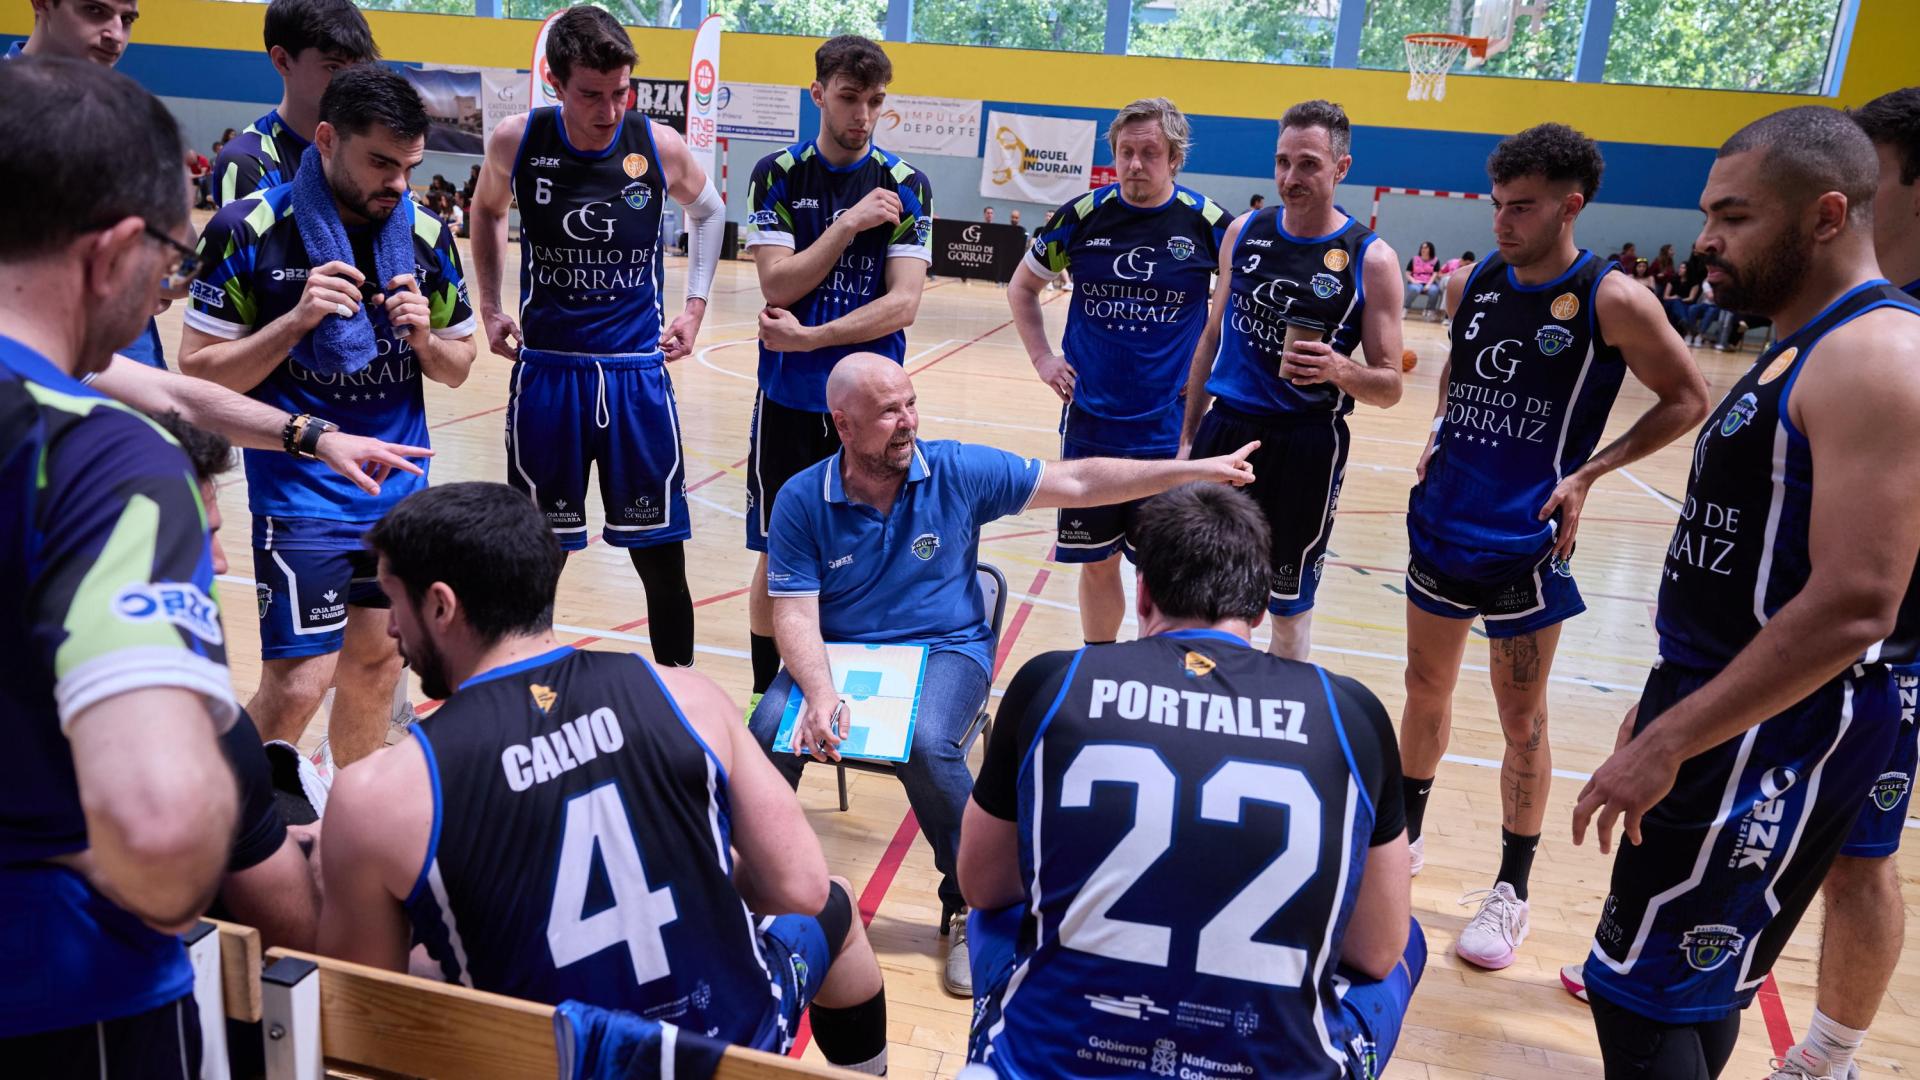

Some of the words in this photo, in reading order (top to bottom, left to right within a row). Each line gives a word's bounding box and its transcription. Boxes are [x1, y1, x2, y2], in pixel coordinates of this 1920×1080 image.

[637, 82, 684, 112] BZK
[691, 117, 713, 133] FNB
[904, 123, 975, 137] DEPORTE
[905, 111, 976, 124] IMPULSA
[690, 133, 713, 148] NSF
[1024, 161, 1082, 174] INDURAIN
[1025, 149, 1068, 161] MIGUEL
[535, 178, 552, 205] 6
[535, 246, 622, 264] CASTILLO
[631, 249, 649, 264] DE
[948, 243, 982, 252] CASTILLO
[984, 246, 993, 254] DE
[948, 251, 993, 264] GORRAIZ
[1242, 254, 1261, 273] 3
[539, 265, 645, 290] GORRAIZ
[1082, 283, 1158, 301] CASTILLO
[1165, 291, 1186, 304] DE
[1084, 299, 1181, 323] GORRAIZ
[1465, 312, 1485, 340] 5
[1448, 382, 1517, 408] CASTILLO
[1525, 397, 1552, 417] DE
[1704, 503, 1741, 533] DE
[1089, 679, 1308, 744] PORTALEZ
[1900, 675, 1919, 724] BZK
[502, 707, 624, 792] CALVO
[1728, 811, 1752, 868] izinka
[1738, 799, 1785, 871] BZK
[1058, 744, 1321, 988] 22
[546, 782, 678, 985] 4
[1089, 1035, 1148, 1056] Gobierno
[1077, 1048, 1093, 1060] de
[1096, 1050, 1146, 1070] Navarra
[1182, 1052, 1254, 1075] Nafarroako
